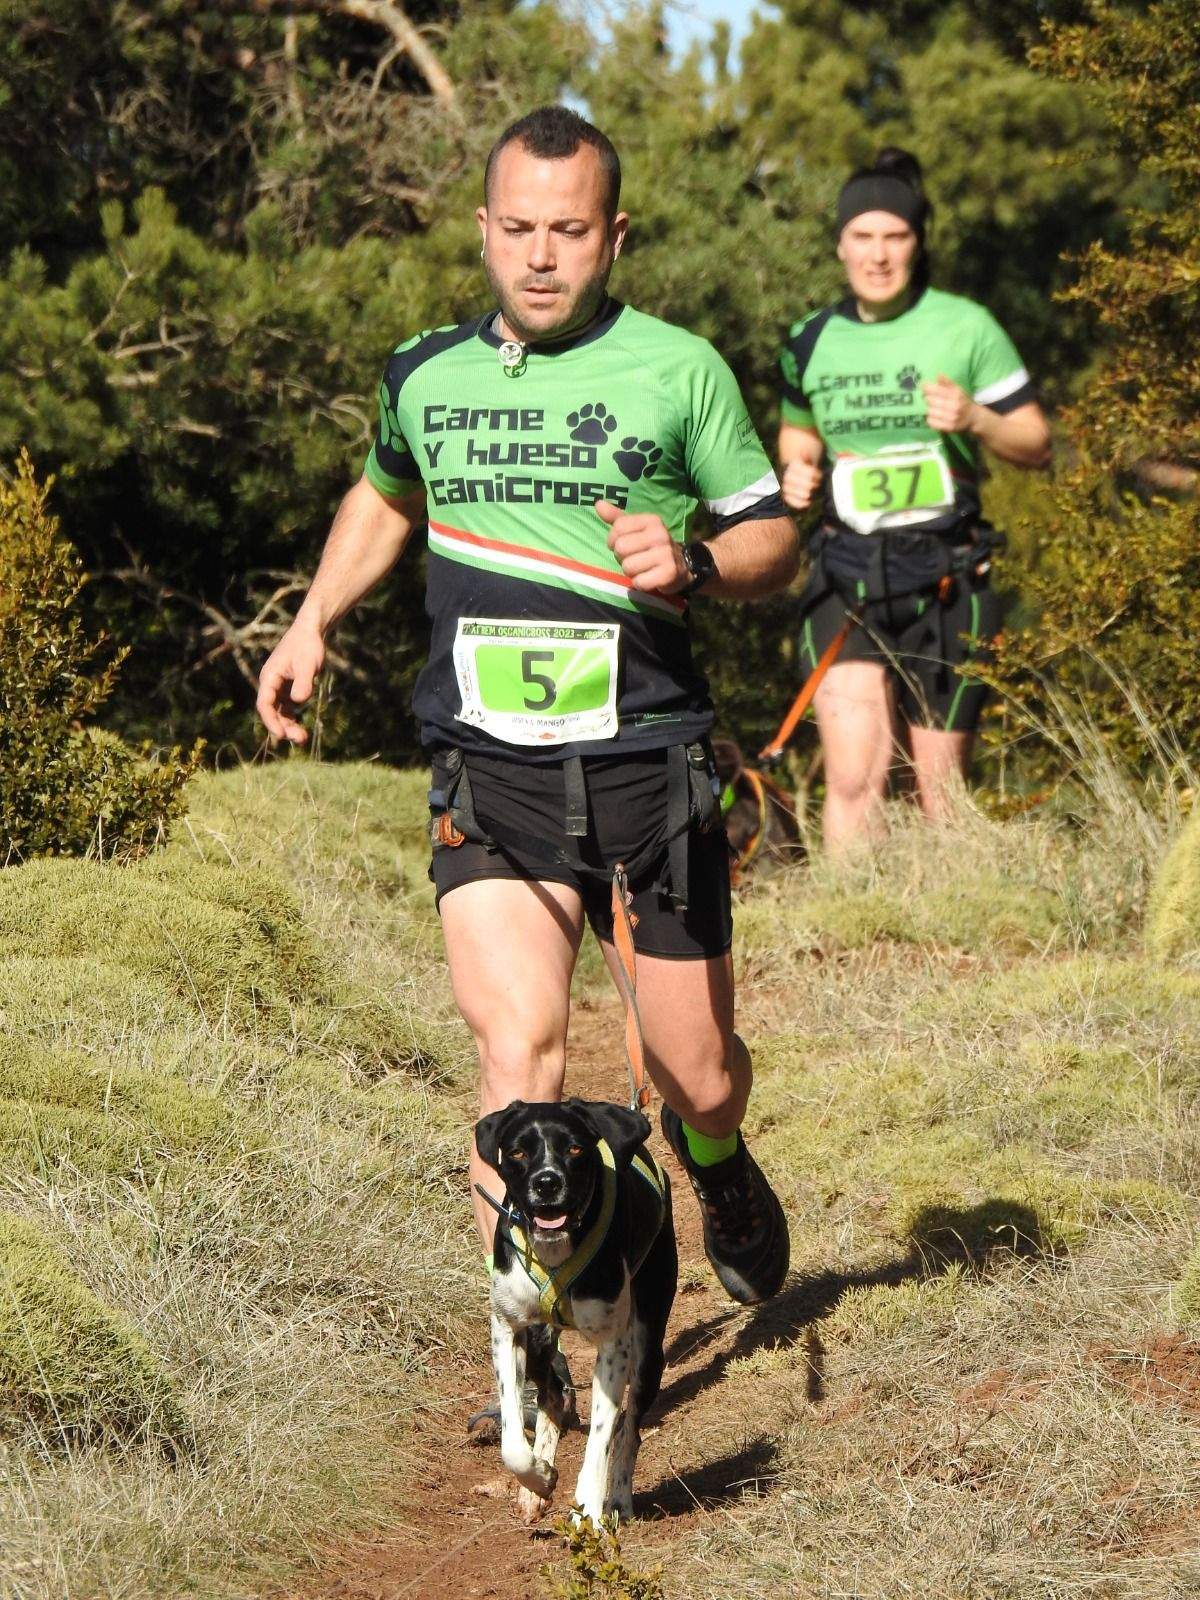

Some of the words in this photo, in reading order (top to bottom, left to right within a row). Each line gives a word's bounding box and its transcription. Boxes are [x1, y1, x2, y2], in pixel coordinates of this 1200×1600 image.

[818, 371, 883, 391] Carne
[821, 394, 834, 411] Y
[423, 404, 544, 434] Carne
[424, 440, 445, 469] Y
[466, 438, 597, 469] hueso
[866, 464, 922, 509] 37
[553, 628, 575, 638] 2023
[521, 650, 557, 711] 5
